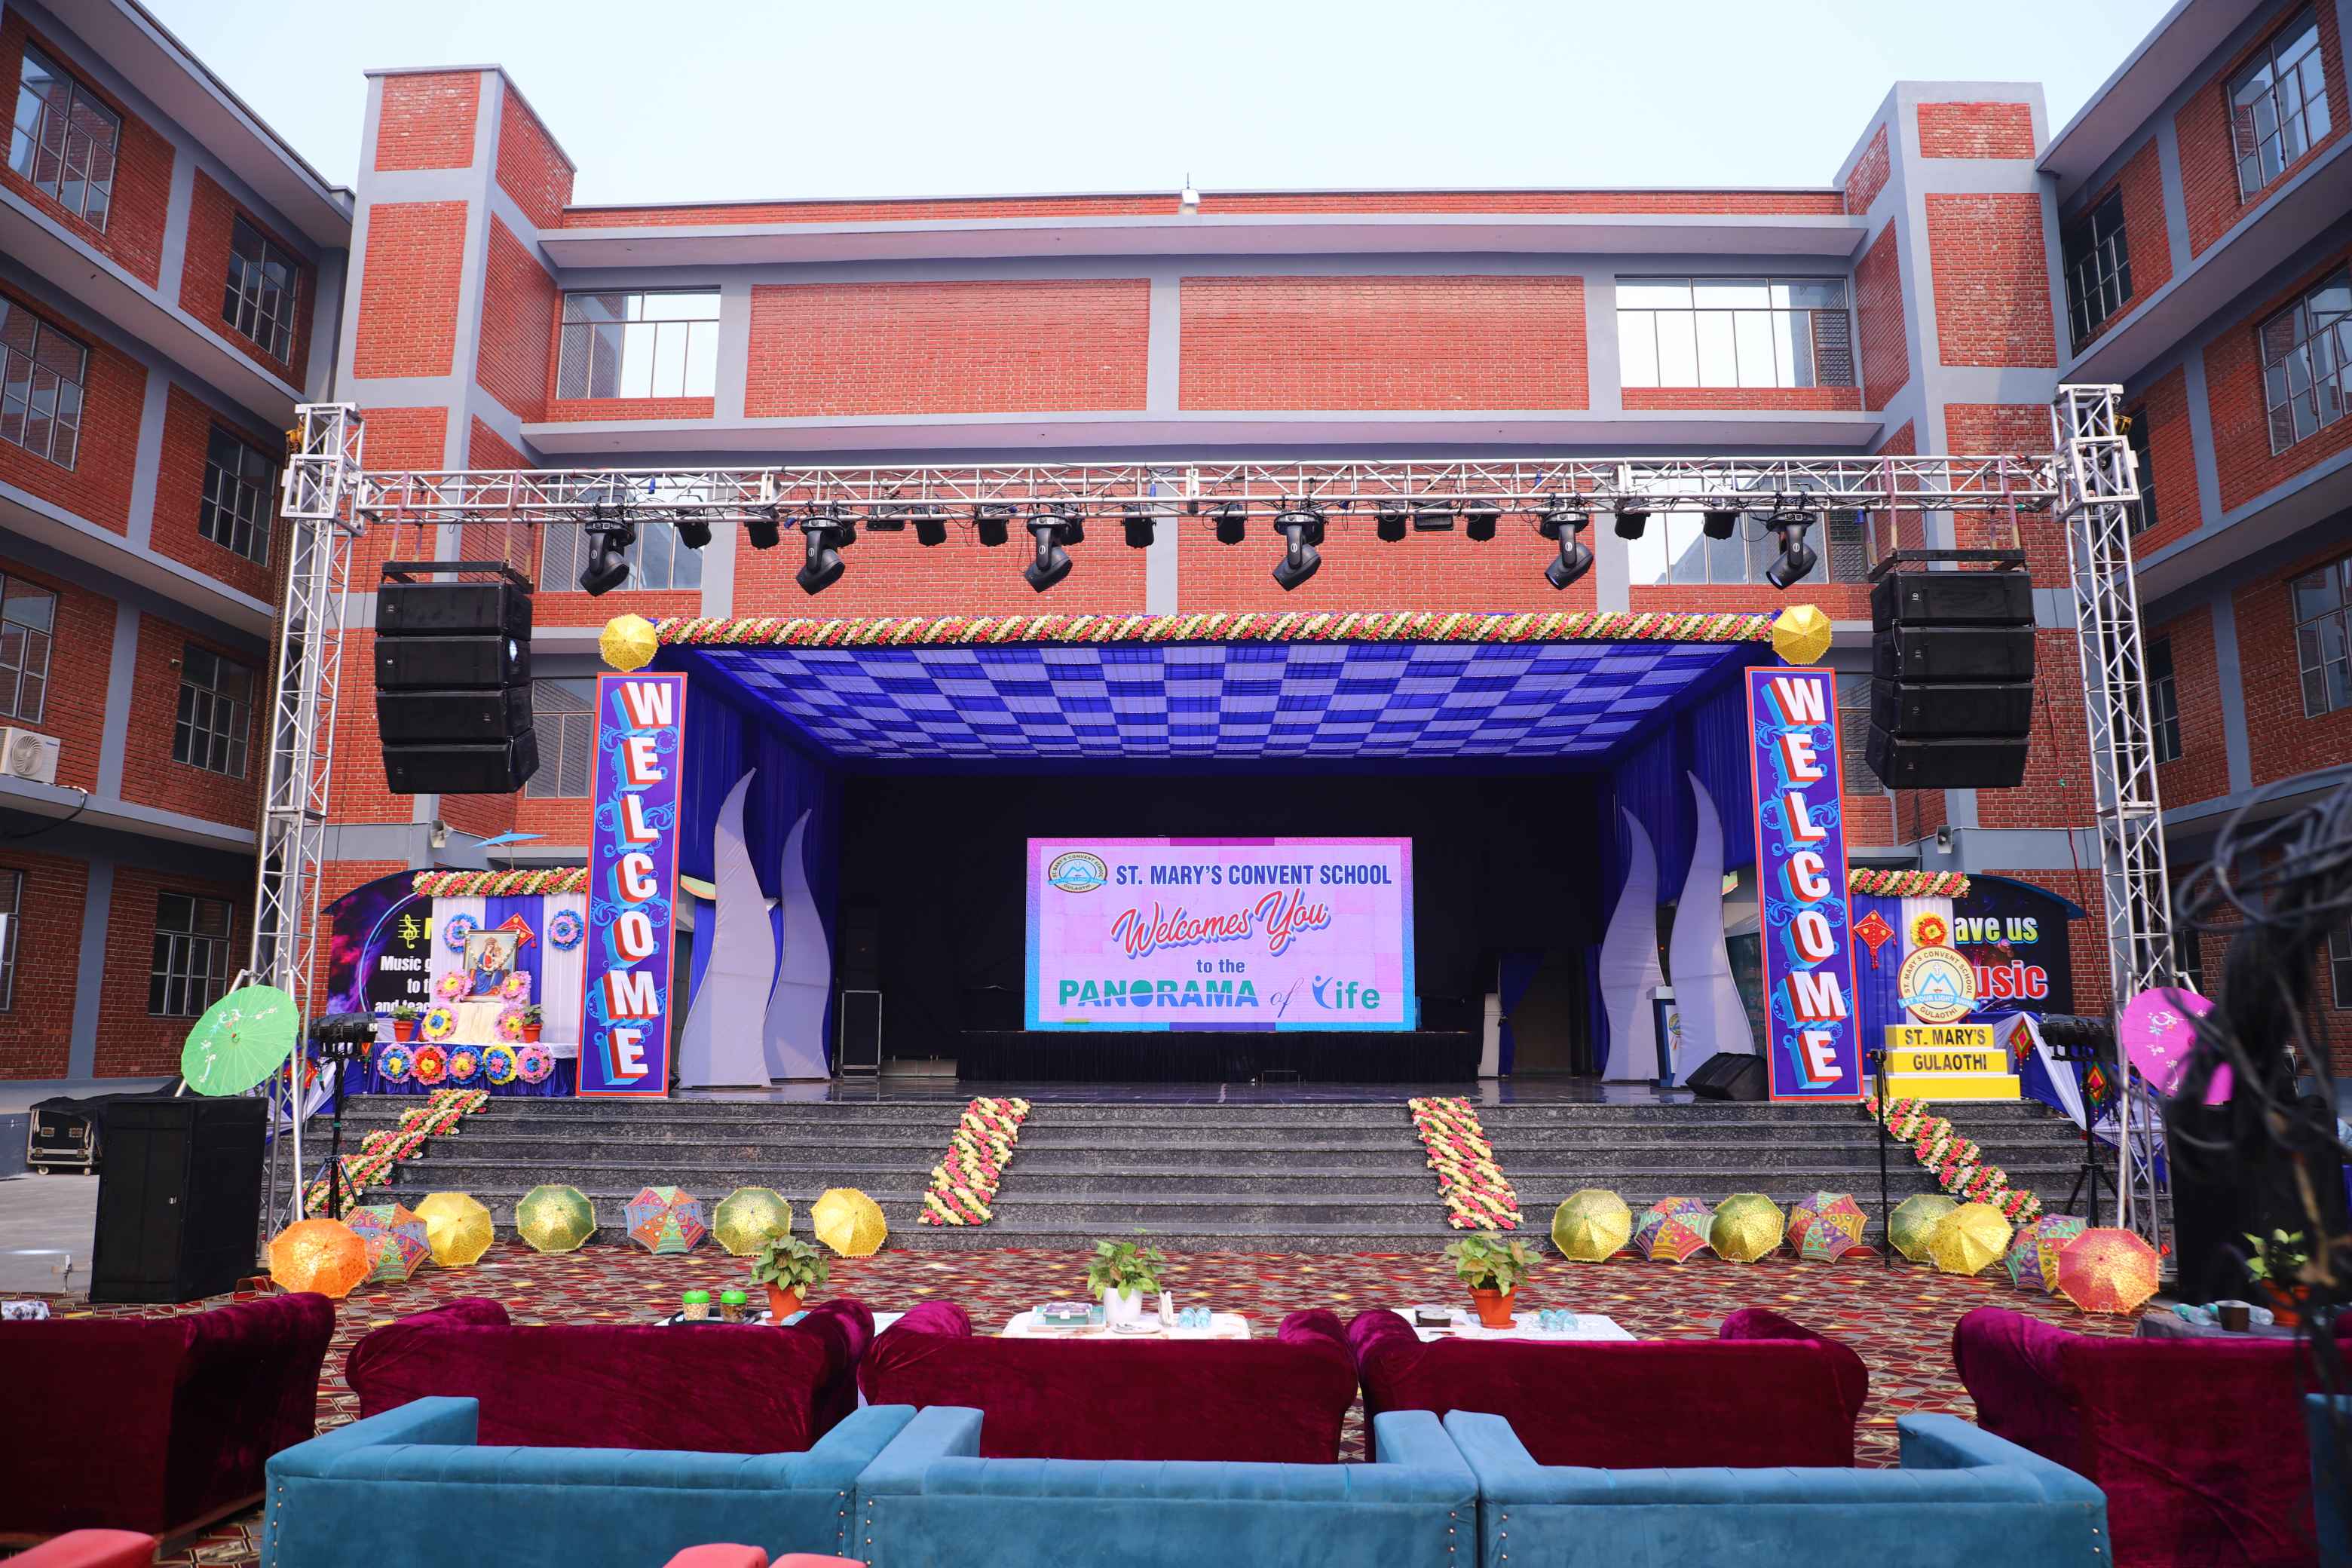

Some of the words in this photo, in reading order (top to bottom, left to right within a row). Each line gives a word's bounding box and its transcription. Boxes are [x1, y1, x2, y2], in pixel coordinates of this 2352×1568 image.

[603, 682, 672, 1080] WELCOME
[1116, 865, 1142, 885] ST.
[1150, 865, 1222, 885] MARY'S
[1229, 865, 1314, 885] CONVENT
[1320, 865, 1392, 885] SCHOOL
[1769, 677, 1848, 1083] WELCOME
[1111, 902, 1251, 955] Welcomes
[1254, 887, 1329, 954] You
[2007, 917, 2039, 944] us
[380, 955, 422, 972] Music
[1196, 959, 1213, 973] to
[1218, 959, 1245, 973] the
[1923, 951, 1960, 964] CONVENT
[1958, 963, 1973, 995] SCHOOL
[406, 978, 421, 994] to
[374, 999, 400, 1013] and
[1058, 978, 1259, 1007] PANORAMA
[1270, 977, 1304, 1018] of
[1916, 994, 1934, 1003] YOUR
[1934, 994, 1954, 1003] LIGHT
[1919, 1006, 1958, 1019] GULAOTHI
[1905, 1029, 1928, 1046] ST.
[1933, 1029, 1986, 1046] MARY'S
[1913, 1054, 1987, 1071] GULAOTHI
